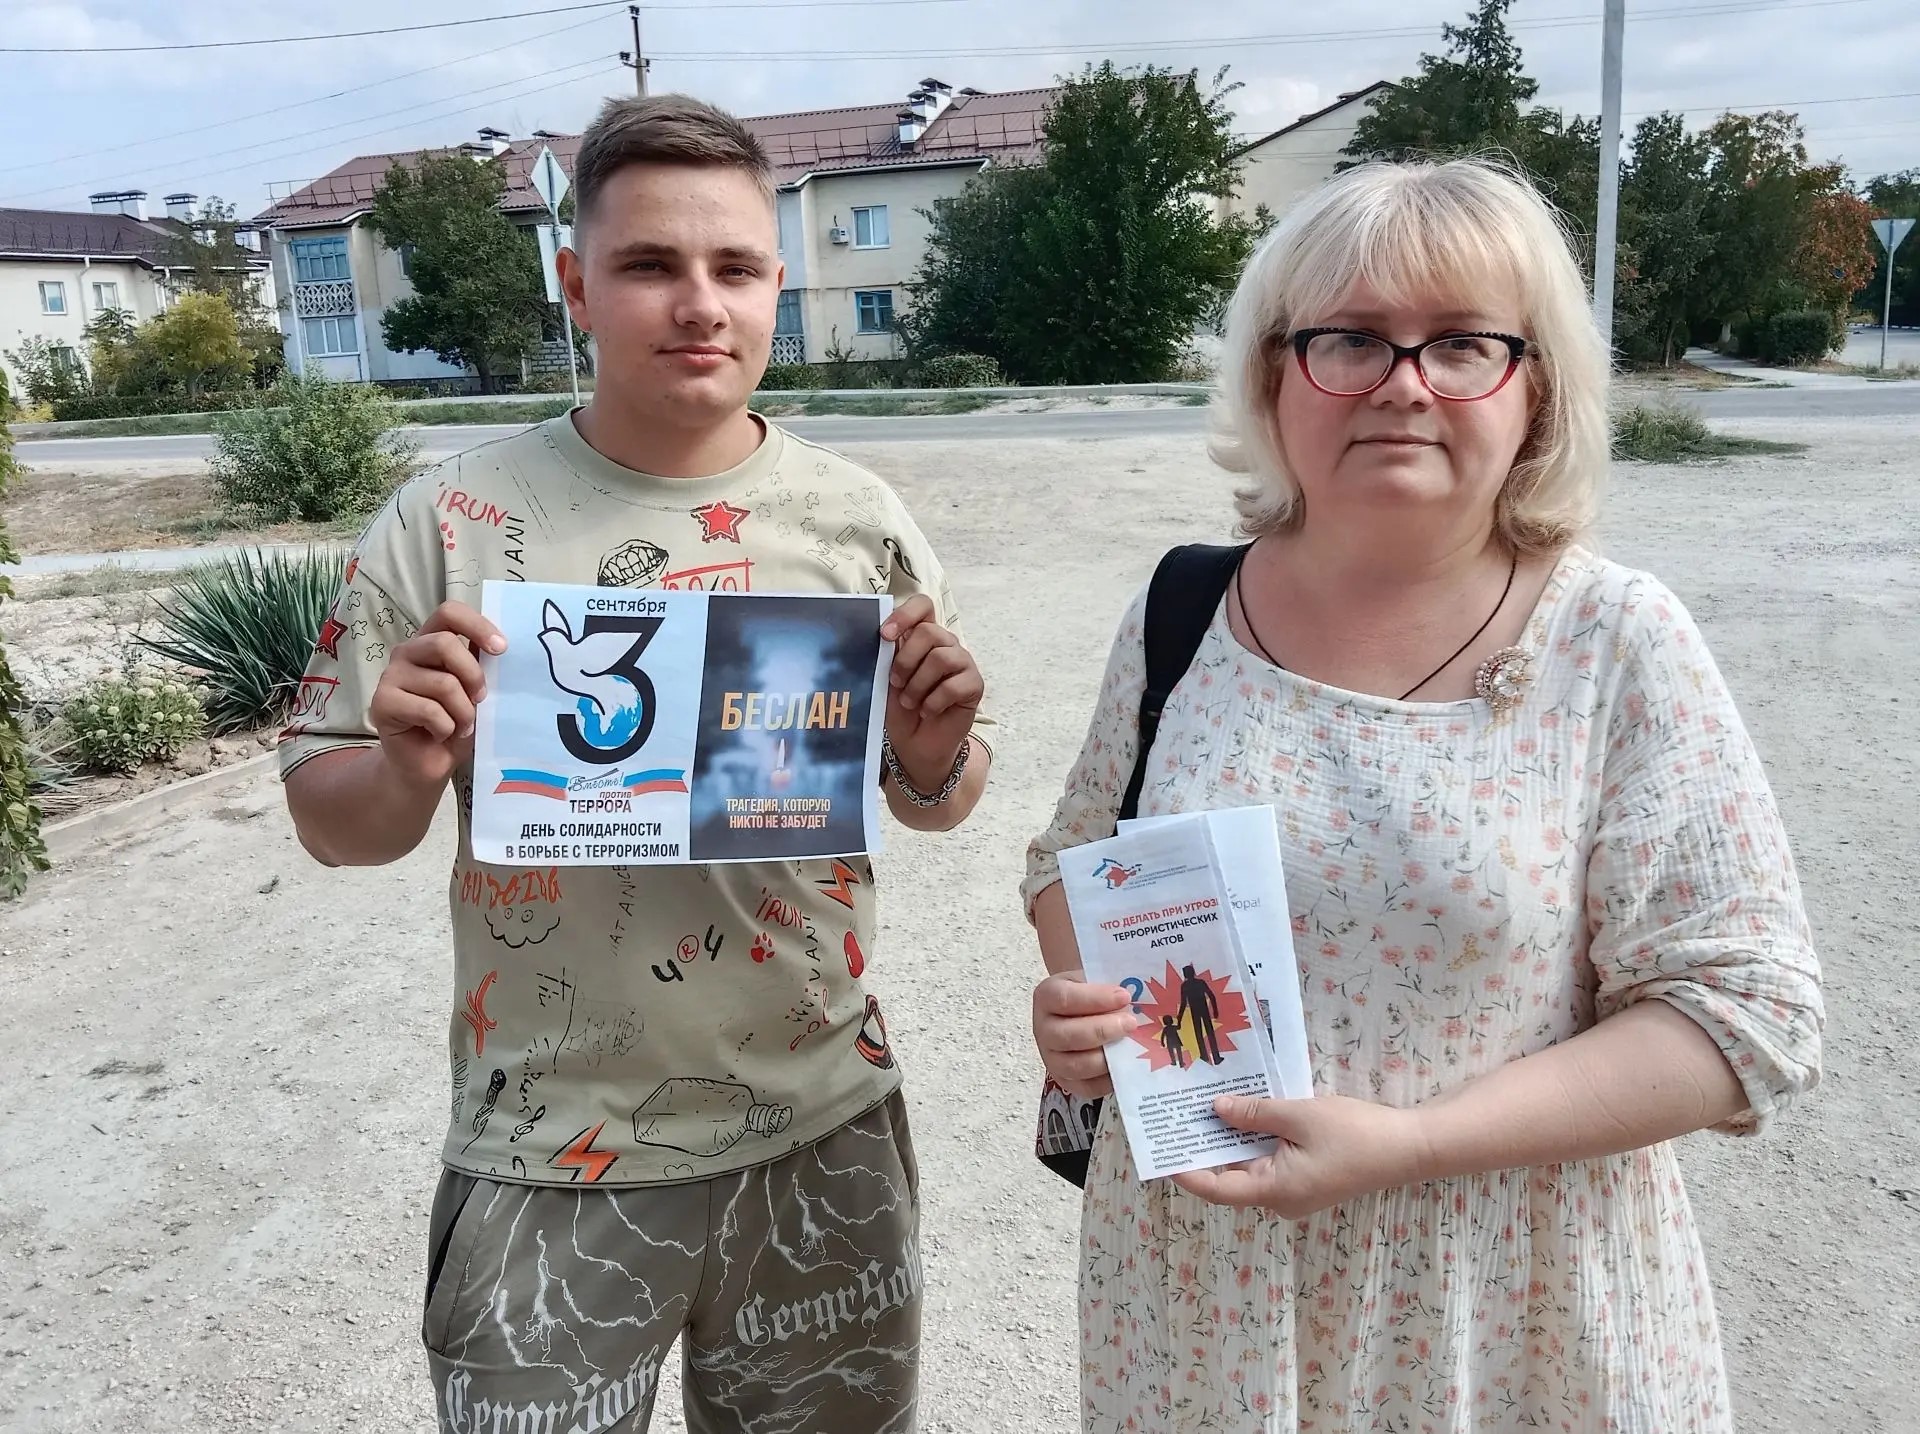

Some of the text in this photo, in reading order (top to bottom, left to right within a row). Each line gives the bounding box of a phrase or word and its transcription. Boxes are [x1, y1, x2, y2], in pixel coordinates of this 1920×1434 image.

[586, 597, 667, 615] сентября
[720, 691, 851, 731] БЕСЛАН
[599, 791, 632, 801] против
[569, 799, 632, 814] ТЕРРОРА
[726, 798, 831, 812] ТРАГЕДИЯ, КОТОРУЮ
[729, 814, 827, 830] НИКТО НЕ ЗАБУДЕТ
[520, 822, 662, 839] ДЕНЬ СОЛИДАРНОСТИ
[506, 843, 679, 859] В БОРЬБЕ С ТЕРРОРИЗМОМ
[1100, 898, 1219, 931] ЧТО ДЕЛАТЬ ПРИ УГРОЗ
[1112, 912, 1218, 943] ТЕРРОРИСТИЧЕСКИХ
[1150, 934, 1184, 950] АКТОВ
